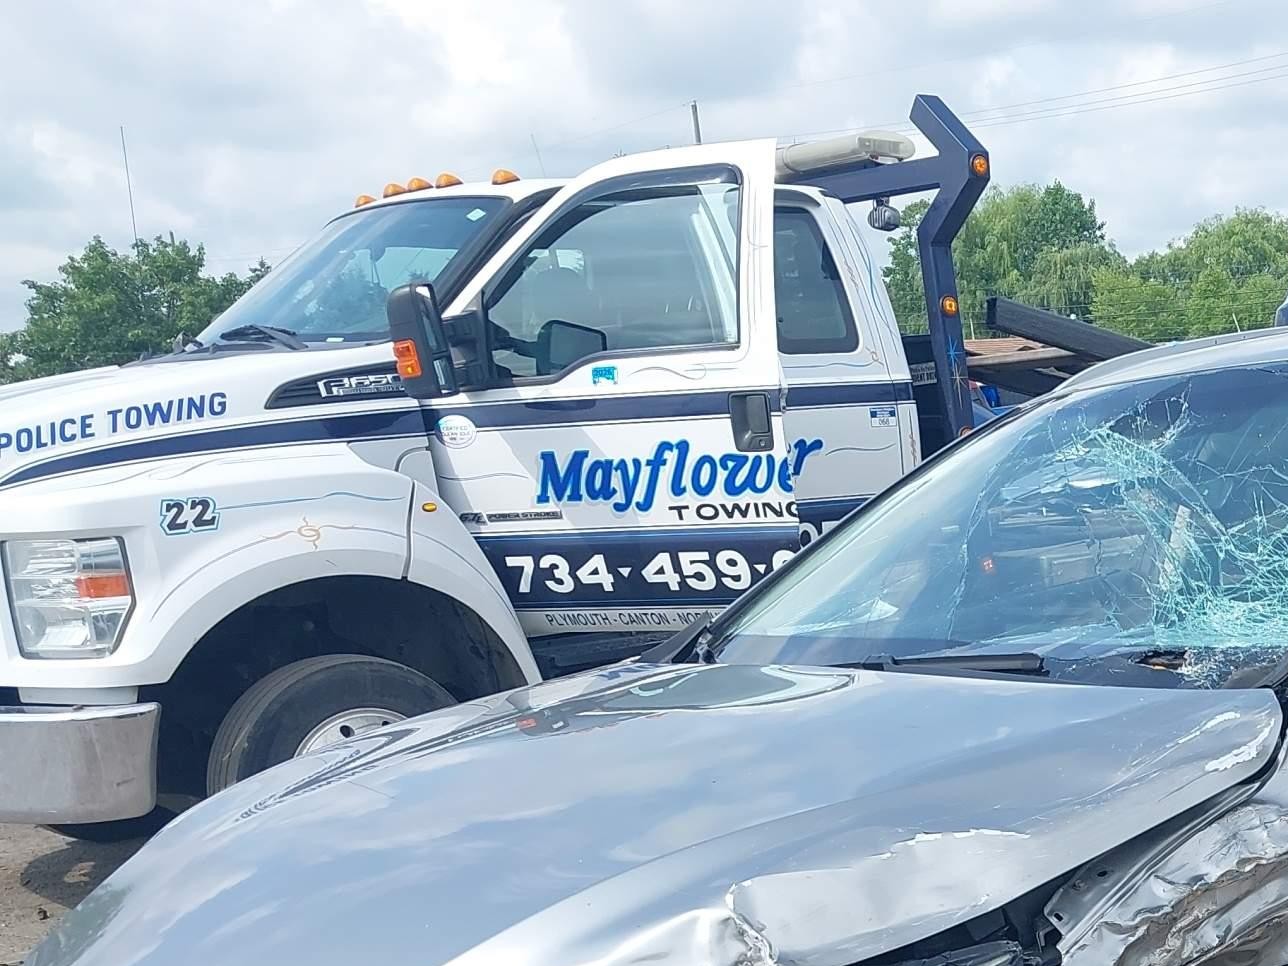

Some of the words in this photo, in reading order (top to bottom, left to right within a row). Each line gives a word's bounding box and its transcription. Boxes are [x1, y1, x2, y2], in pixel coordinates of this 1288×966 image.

[0, 413, 95, 455] POLICE
[107, 392, 228, 434] TOWING
[536, 438, 824, 513] Mayflower
[163, 497, 219, 534] 22
[544, 612, 612, 626] PLYMOUTH
[618, 612, 671, 625] CANTON
